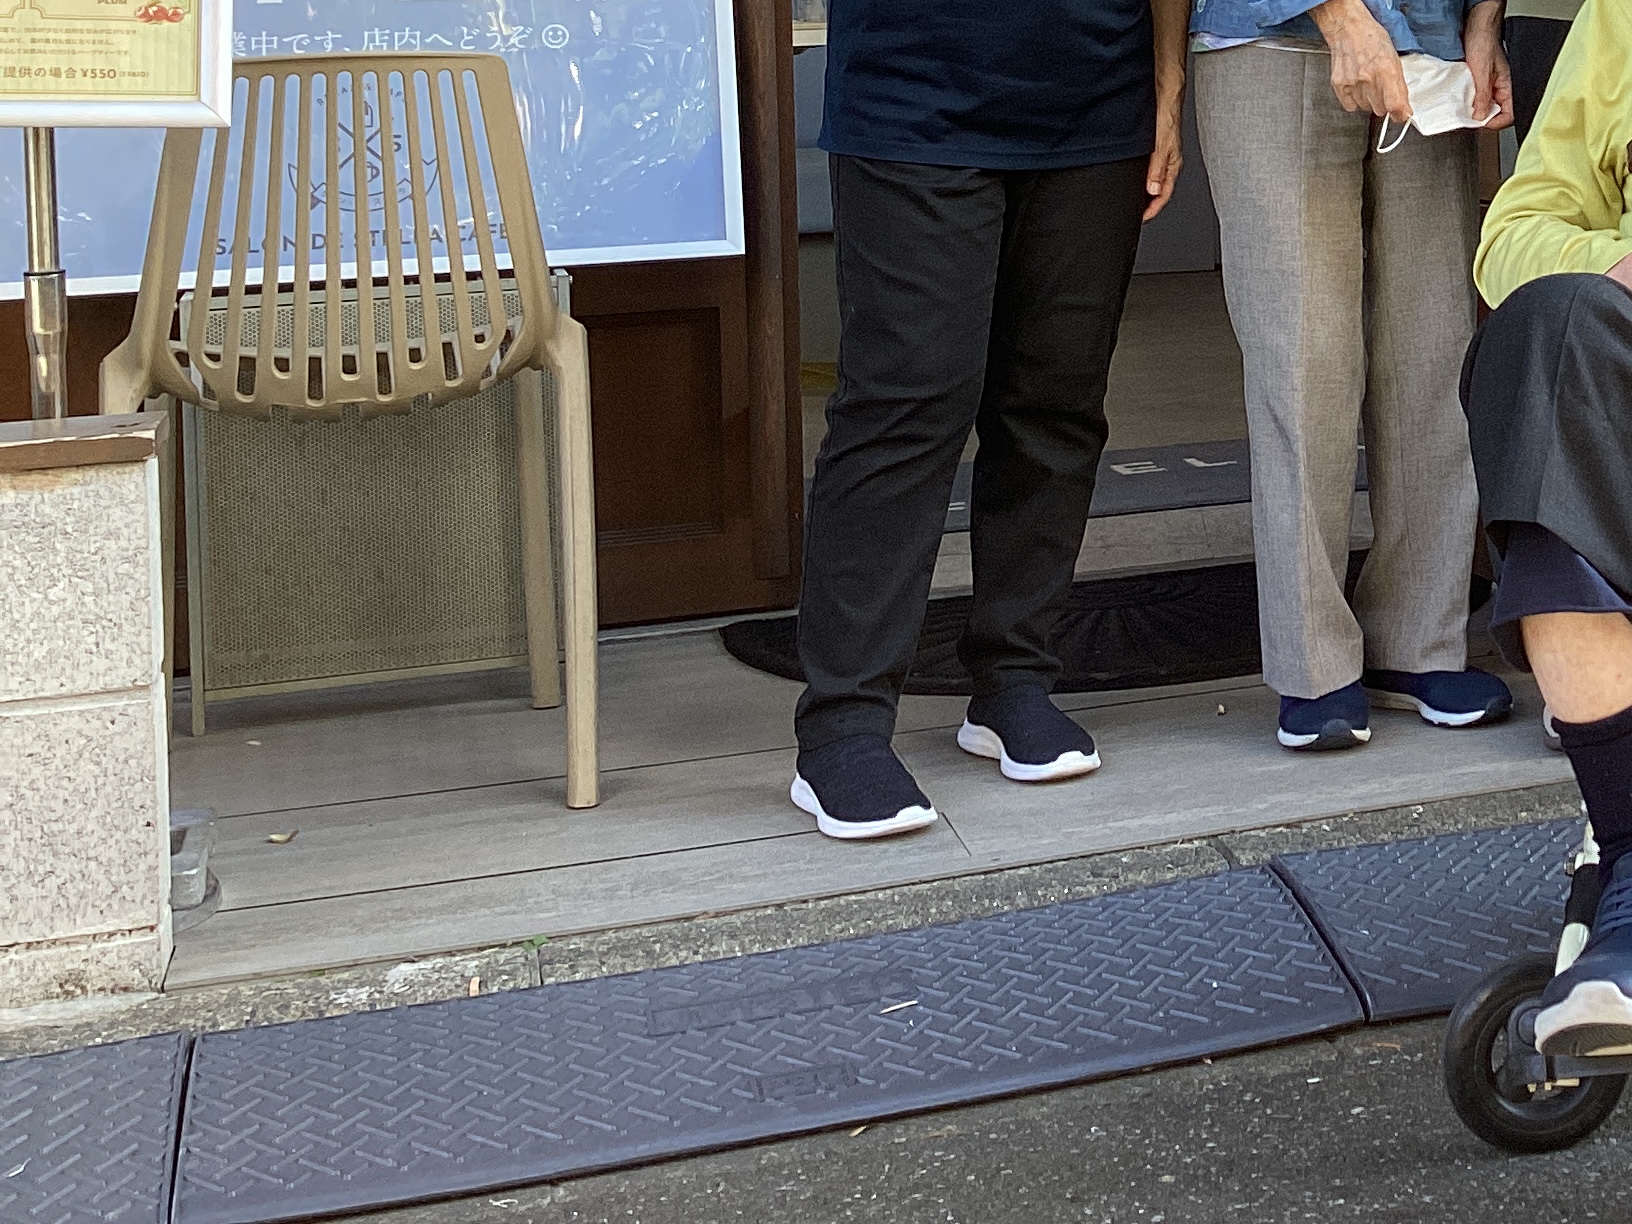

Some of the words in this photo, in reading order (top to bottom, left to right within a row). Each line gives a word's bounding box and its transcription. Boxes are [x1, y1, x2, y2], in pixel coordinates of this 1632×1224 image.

[0, 66, 77, 79] 提供の場合
[80, 68, 117, 79] ¥550
